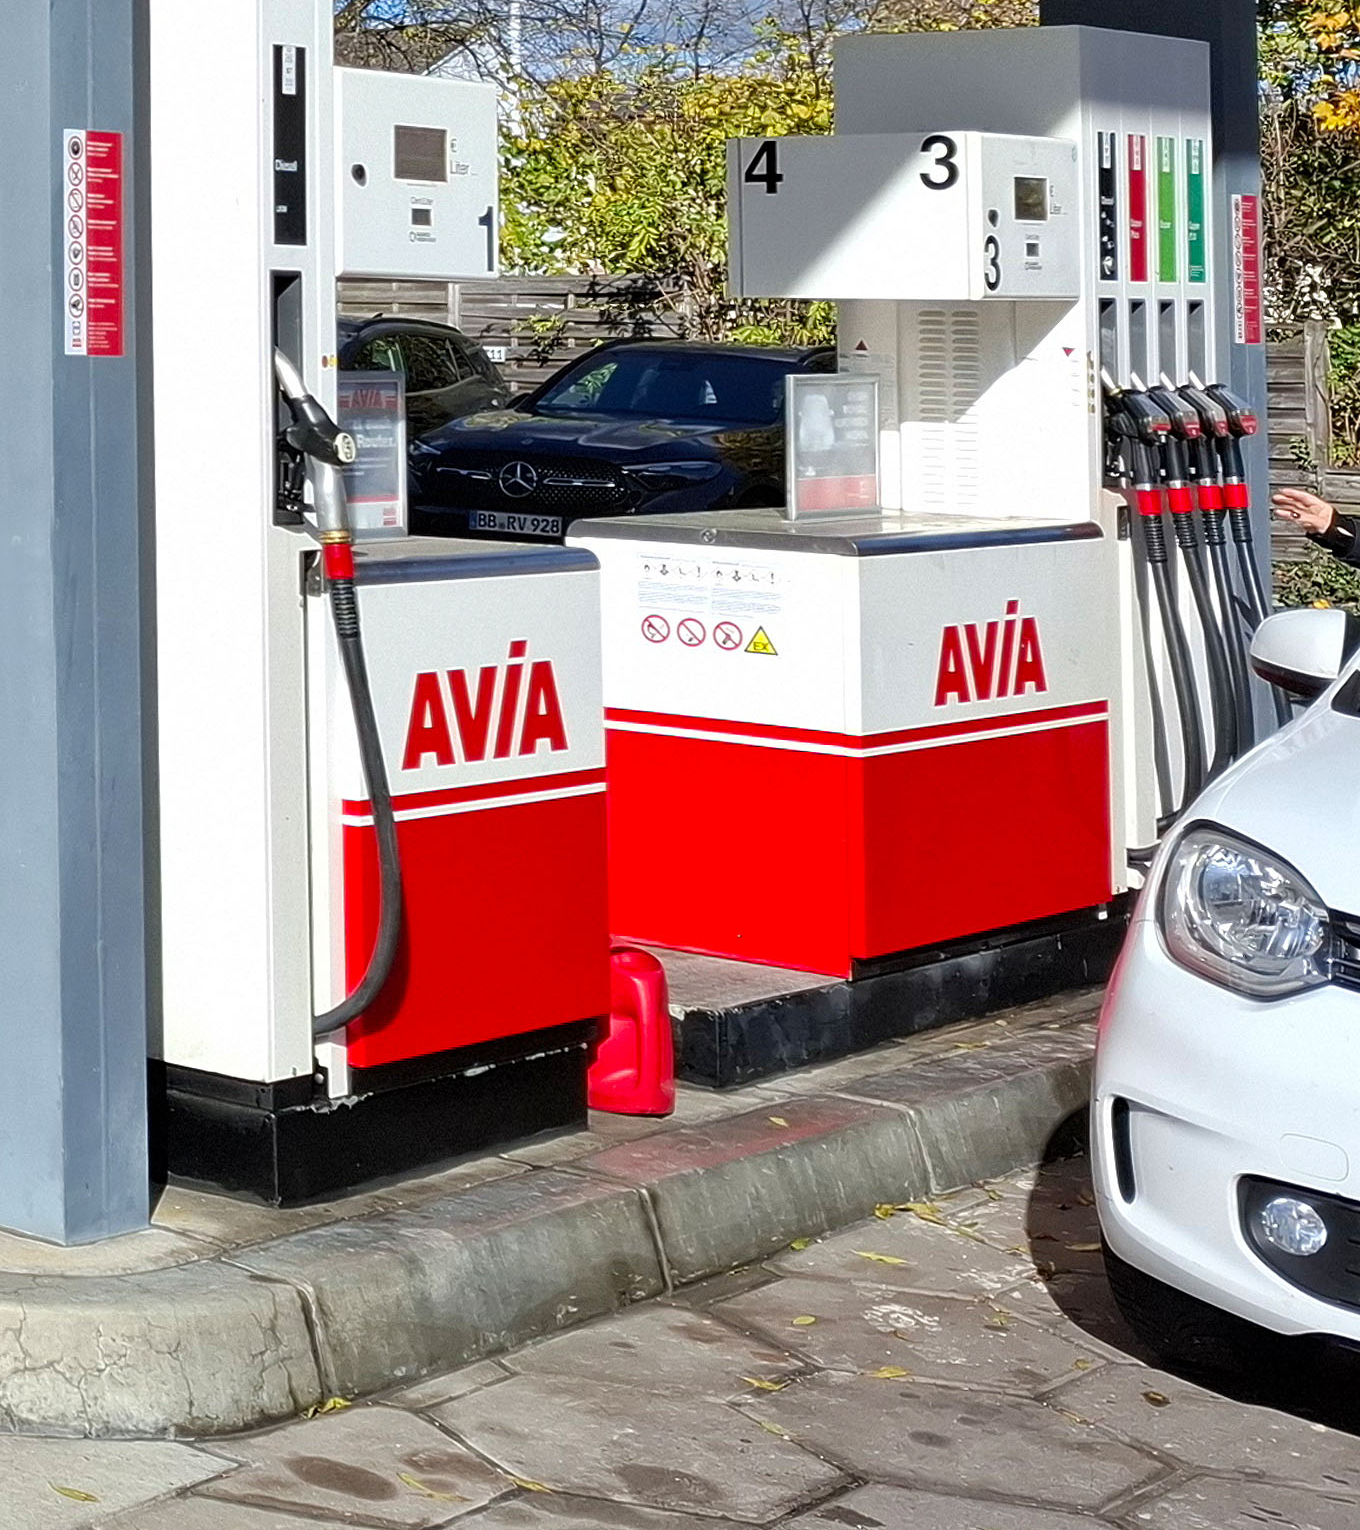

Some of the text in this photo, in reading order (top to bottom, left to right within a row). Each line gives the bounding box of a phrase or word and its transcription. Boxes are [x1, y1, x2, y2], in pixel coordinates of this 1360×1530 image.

[744, 140, 784, 195] 4
[919, 134, 960, 191] 3
[478, 205, 494, 271] 1
[984, 235, 1001, 291] 3
[478, 512, 560, 534] BB RV 928
[753, 641, 770, 652] EX
